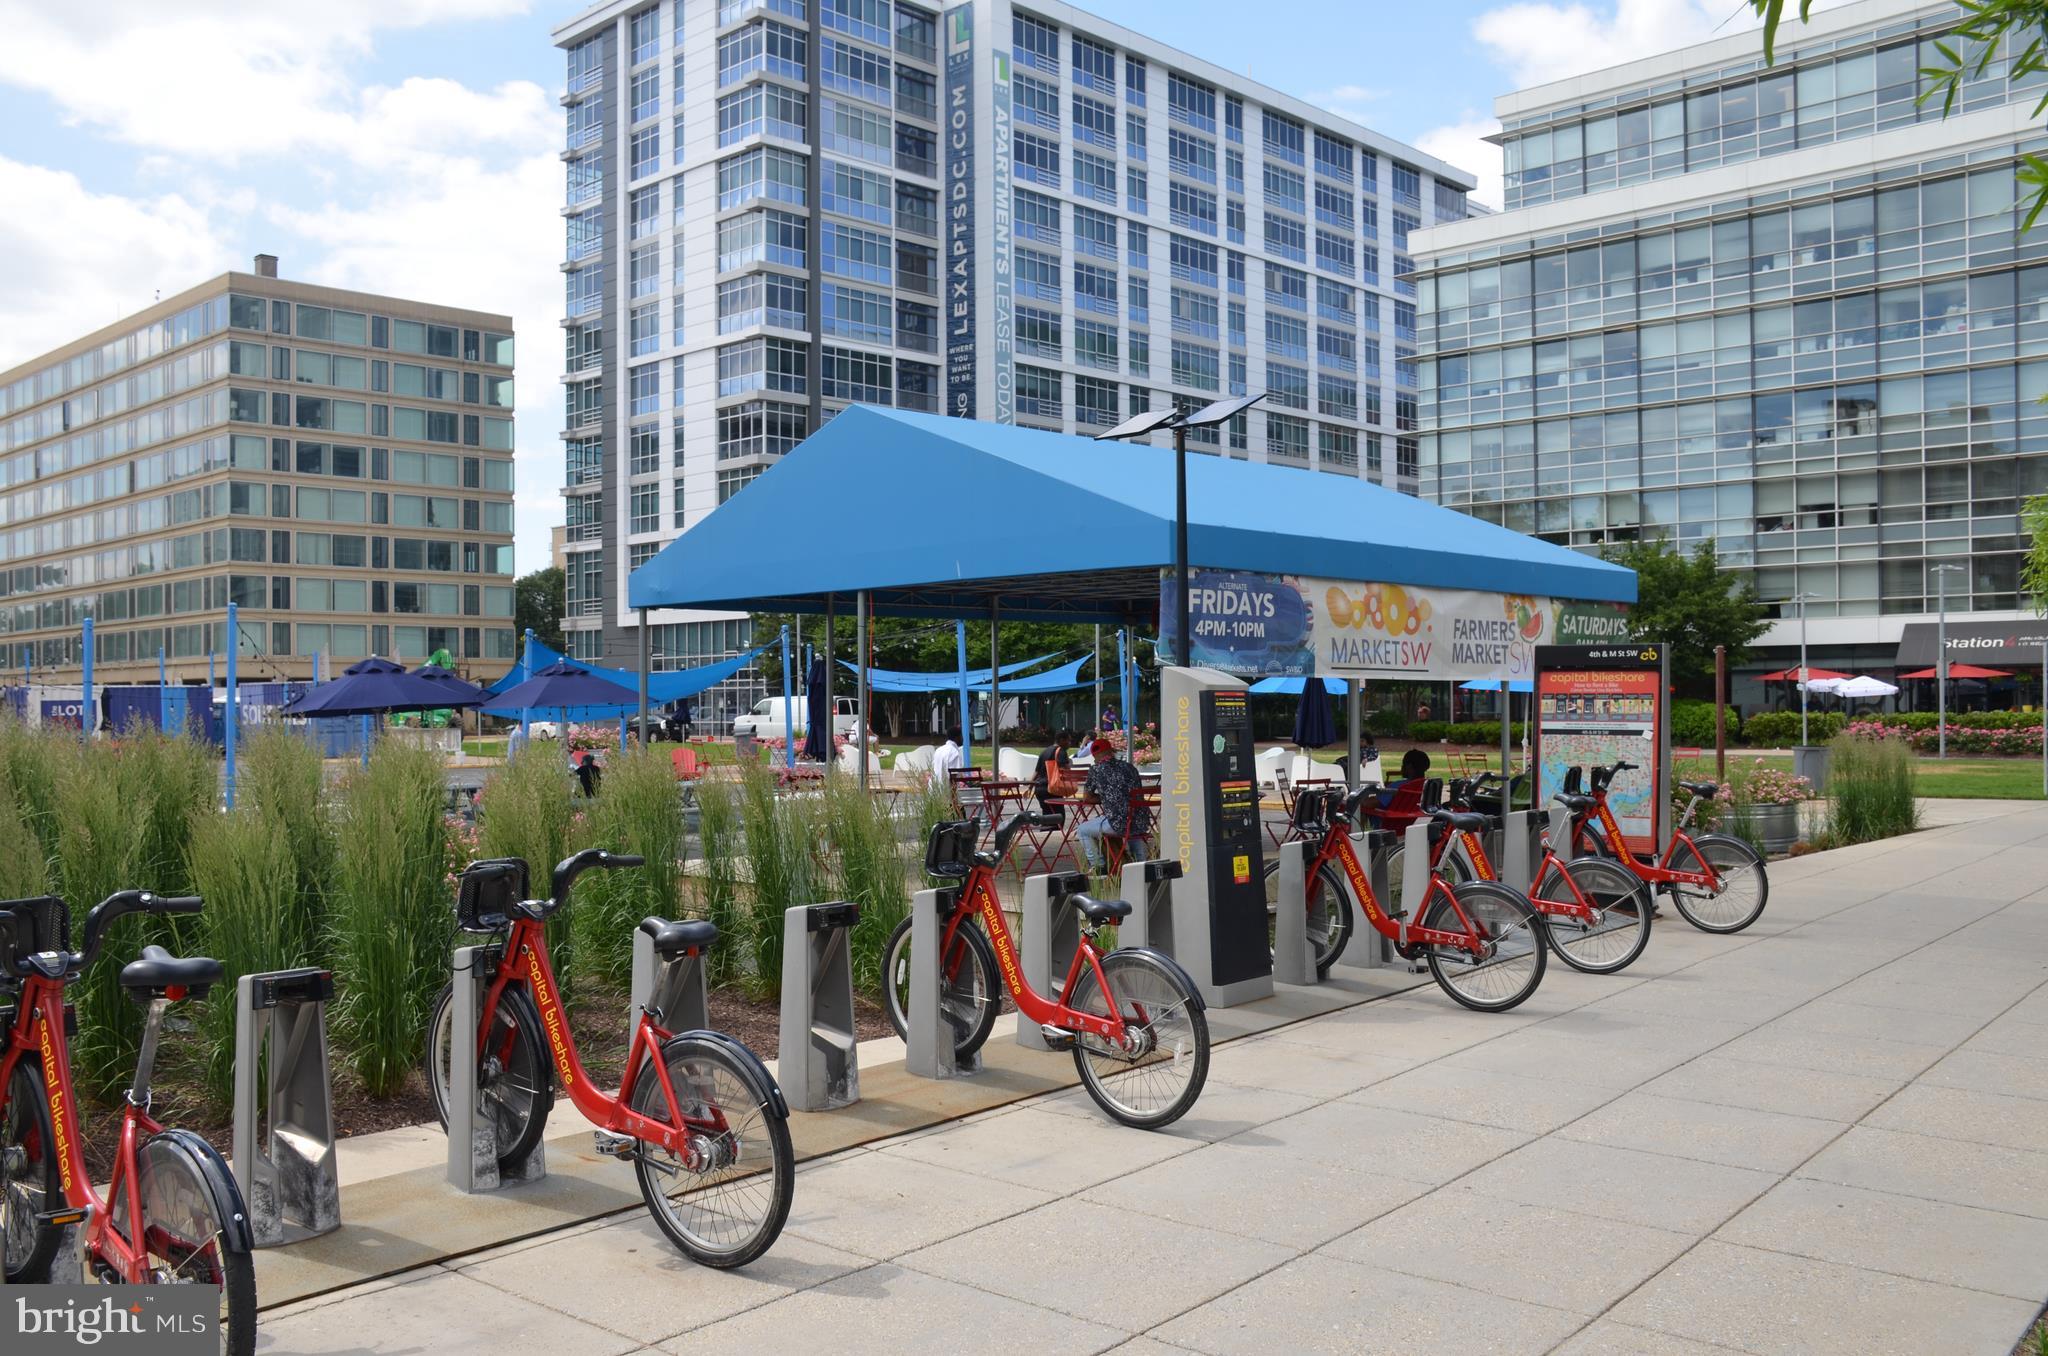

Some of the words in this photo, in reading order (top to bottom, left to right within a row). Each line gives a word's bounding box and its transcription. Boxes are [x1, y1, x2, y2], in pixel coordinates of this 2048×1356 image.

[995, 105, 1010, 275] APARTMENTS
[952, 85, 968, 335] LEXAPTSDC.COM
[996, 283, 1010, 353] LEASE
[949, 344, 974, 354] WHERE
[954, 355, 968, 363] YOU
[952, 364, 971, 373] WANT
[1218, 582, 1248, 591] ALTERNATE
[1188, 588, 1275, 617] FRIDAYS
[1195, 620, 1265, 637] 4PM-10PM
[1453, 618, 1516, 641] FARMERS
[1562, 614, 1628, 636] SATURDAYS
[1588, 650, 1600, 658] 4th
[1550, 673, 1589, 684] capital
[1591, 672, 1645, 682] bikeshare
[59, 704, 84, 716] LOT
[1172, 696, 1190, 796] bikeshare
[1174, 804, 1193, 873] capital
[1599, 806, 1616, 831] capital
[1612, 830, 1629, 865] bikeshare
[1339, 843, 1358, 877] capital
[1354, 876, 1378, 920] bikeshare
[981, 892, 1002, 936] capital
[997, 935, 1021, 995] bikeshare
[527, 951, 551, 1007] capital
[545, 1007, 573, 1086] bikeshare
[40, 1018, 60, 1090] capital
[50, 1090, 73, 1190] bikeshare
